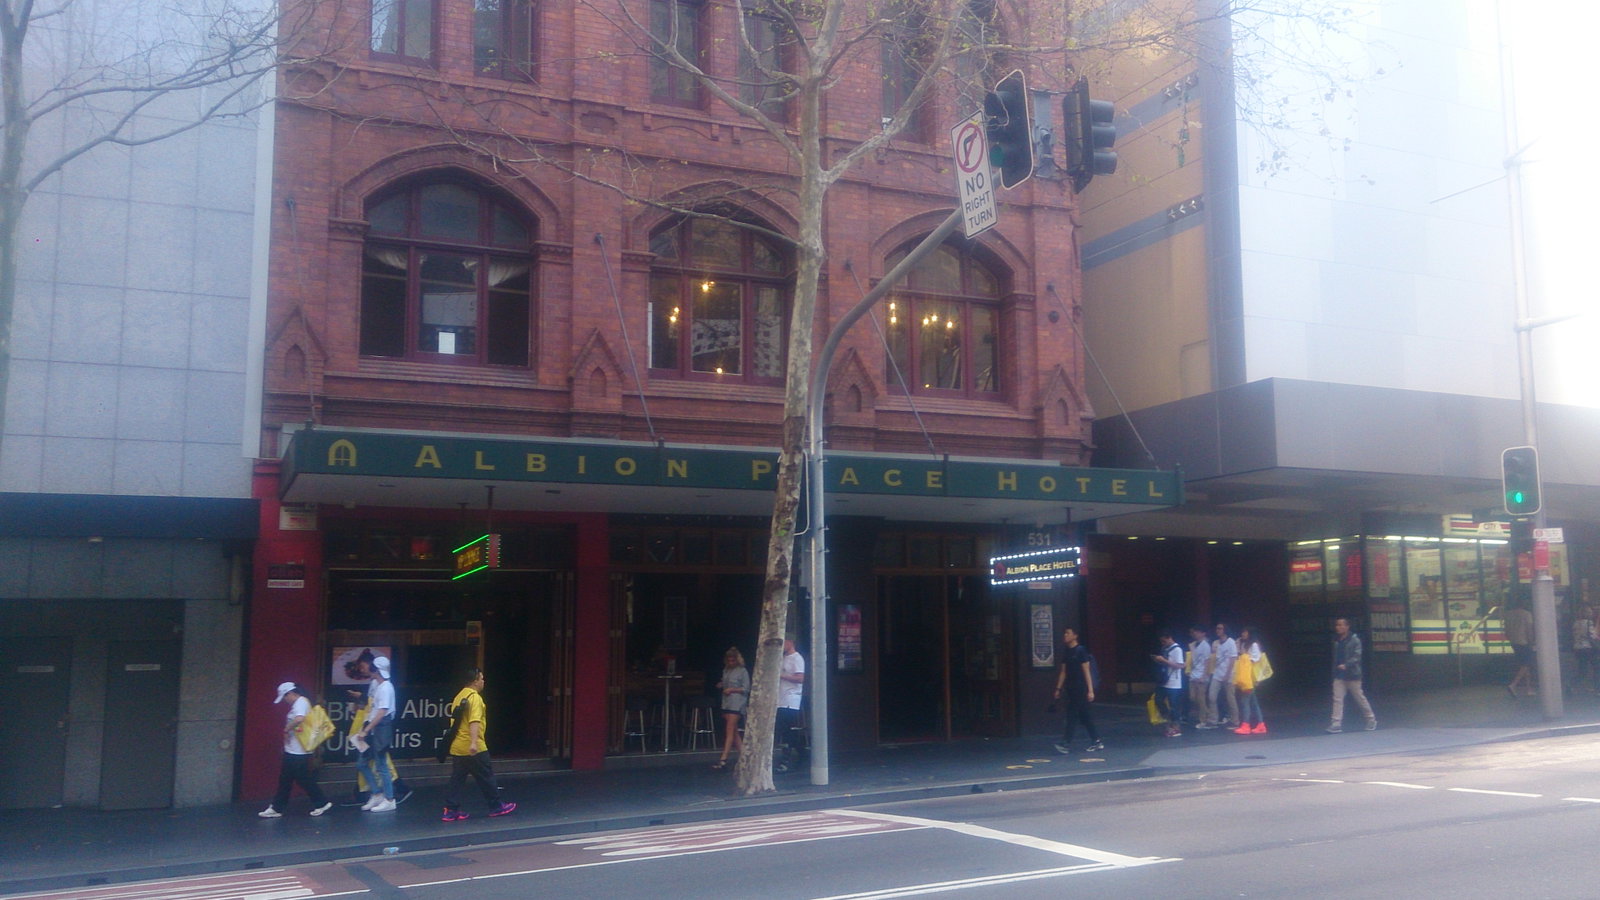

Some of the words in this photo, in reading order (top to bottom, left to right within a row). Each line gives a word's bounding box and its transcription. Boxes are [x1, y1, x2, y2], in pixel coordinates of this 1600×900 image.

[965, 172, 985, 196] NO
[965, 191, 990, 214] RIGHT
[969, 208, 993, 229] TURN
[415, 445, 688, 478] ALBION
[752, 460, 943, 488] PACE
[998, 471, 1163, 497] HOTEL
[1028, 533, 1051, 546] 531
[1006, 566, 1029, 575] ALBION
[1030, 563, 1052, 572] PLACE
[1053, 561, 1076, 570] HOTEL
[401, 698, 453, 719] Albio
[327, 729, 421, 755] Upirs
